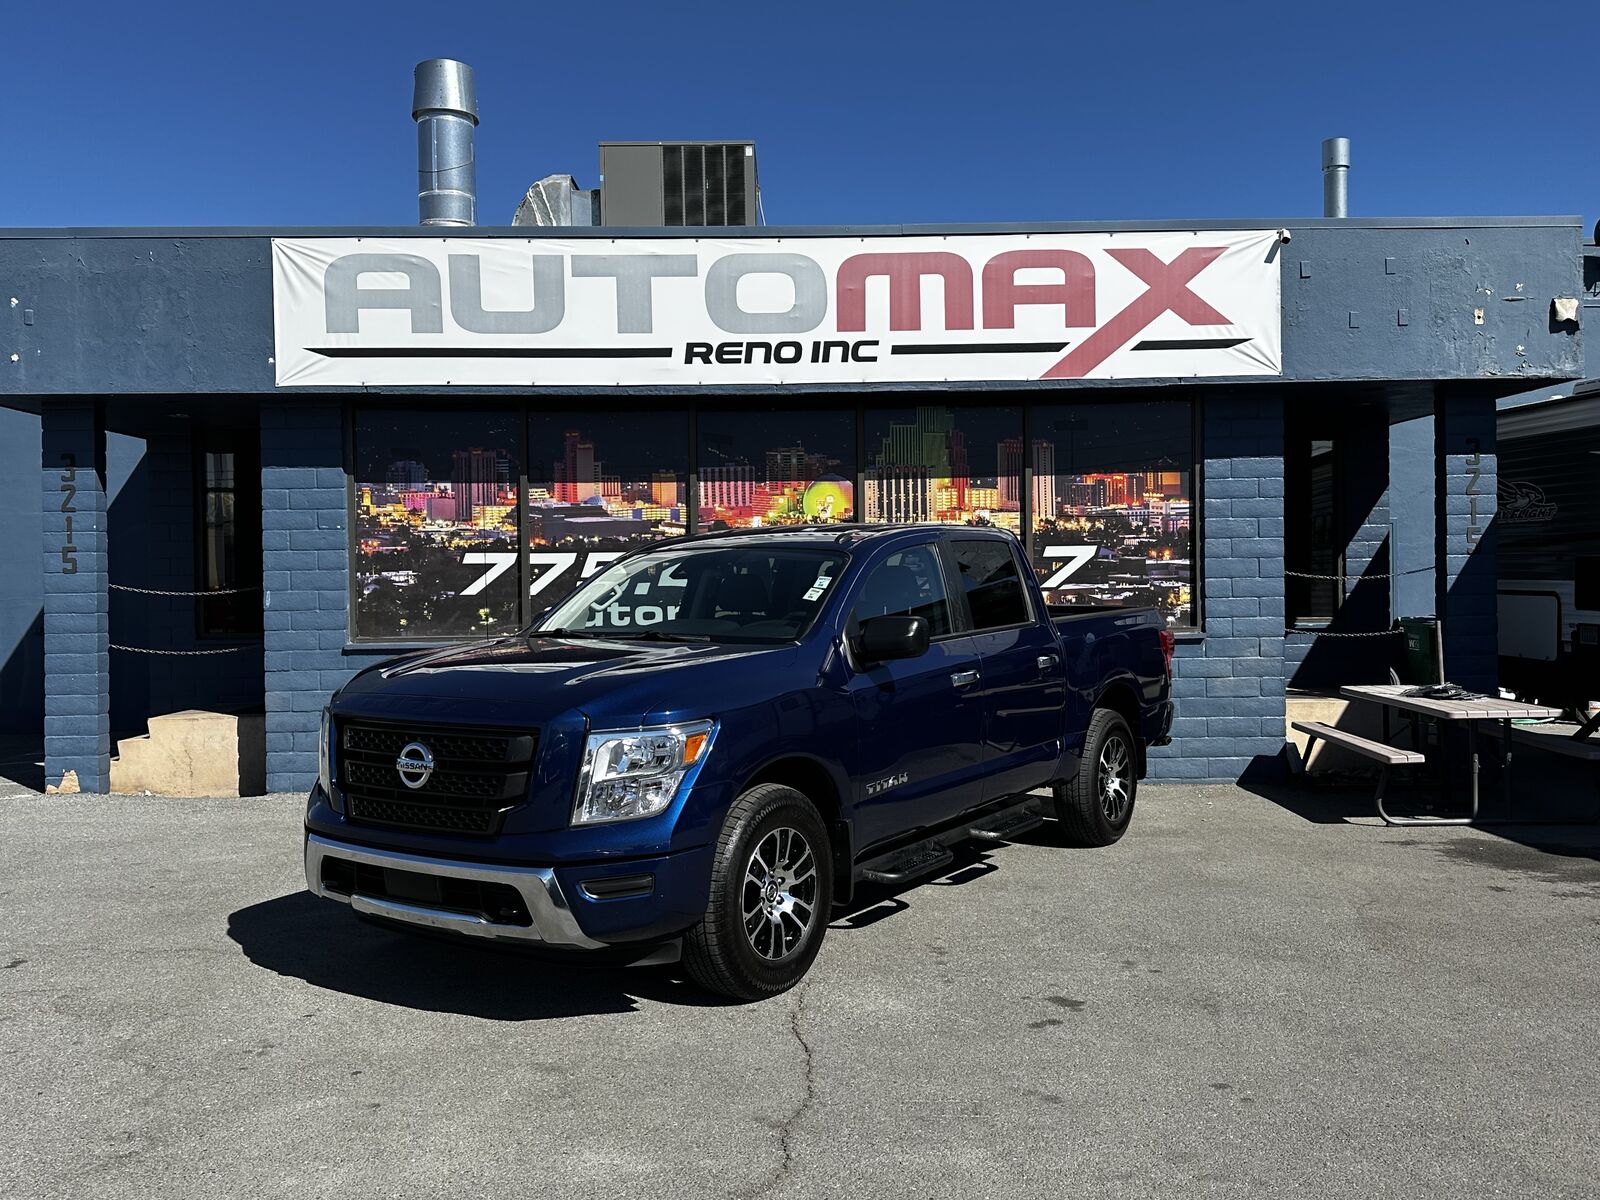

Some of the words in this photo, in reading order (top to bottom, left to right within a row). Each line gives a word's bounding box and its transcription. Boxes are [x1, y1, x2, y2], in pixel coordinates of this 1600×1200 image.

[324, 246, 1234, 379] AUTOMAX
[684, 341, 803, 364] RENO
[810, 340, 880, 363] INC
[61, 453, 77, 574] 3215
[397, 761, 428, 771] NISSAN
[866, 771, 908, 795] TITAN
